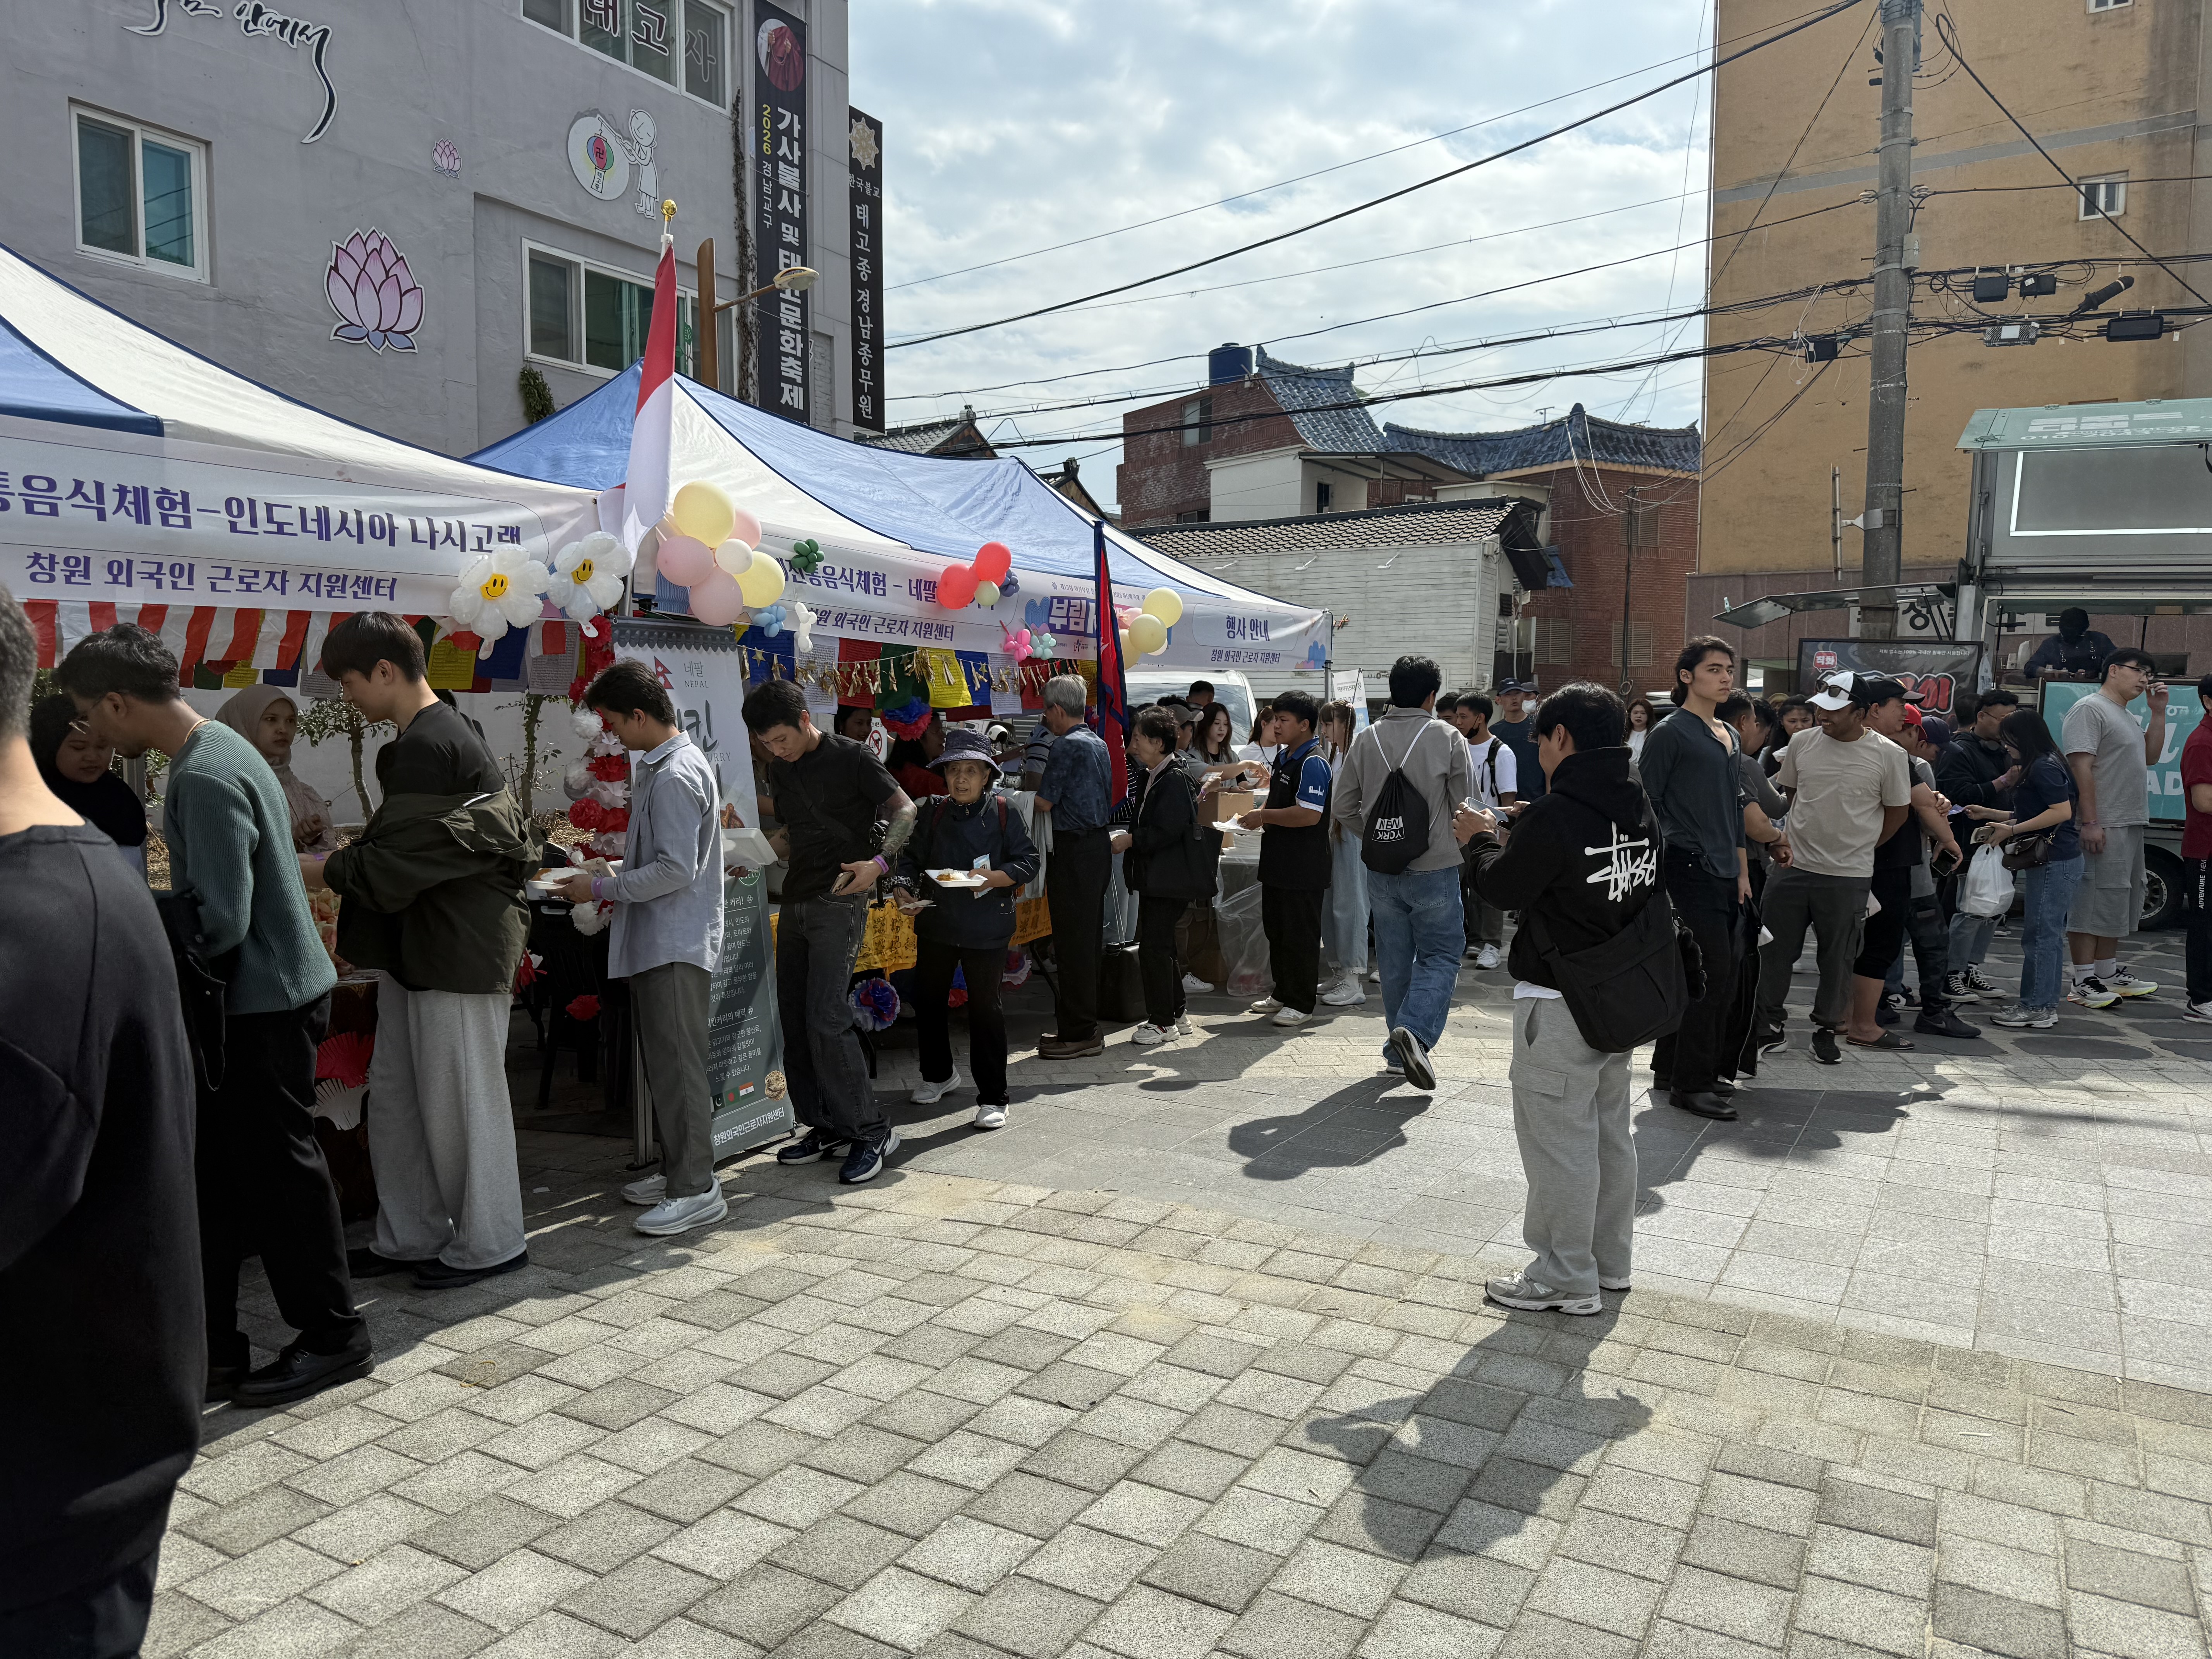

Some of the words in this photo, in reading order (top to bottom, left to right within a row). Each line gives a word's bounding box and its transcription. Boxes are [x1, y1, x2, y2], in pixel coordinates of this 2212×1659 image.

[763, 104, 771, 155] 2026
[776, 106, 802, 218] 가사불사
[848, 173, 880, 198] 한국불교
[763, 160, 773, 228] 경남교구
[781, 222, 800, 247] 및
[855, 203, 871, 282] 태고종
[857, 288, 874, 420] 경남종무원
[26, 551, 91, 586] 창원
[106, 558, 195, 591] 외국인
[206, 564, 290, 596] 근로자
[297, 572, 398, 601] 지원센터
[908, 578, 938, 603] 네팔
[832, 611, 872, 632] 외국인
[874, 616, 909, 637] 근로자
[911, 622, 955, 642] 지원센터
[1226, 615, 1247, 640] 행사
[1250, 618, 1270, 641] 안내
[1211, 649, 1224, 662] 창원
[1224, 650, 1242, 663] 외국인
[1242, 651, 1259, 664] 근로자
[1259, 652, 1281, 664] 지원센터
[1816, 656, 1835, 666] 직화
[684, 661, 704, 677] 네팔
[685, 680, 709, 688] NEPAL
[707, 752, 731, 762] URRY
[1376, 830, 1402, 840] YORK
[729, 896, 744, 907] 커리!
[735, 915, 749, 925] 인도의
[737, 939, 751, 948] 만드는
[744, 961, 754, 969] 여러
[723, 978, 732, 988] 깊고
[733, 974, 747, 985] 풍부한
[711, 993, 721, 1003] 것이
[721, 986, 746, 999] 특징입니다.
[712, 1034, 731, 1046] 닭고기와
[737, 1037, 755, 1051] 감칠맛이
[718, 1056, 738, 1068] 따뜻하고
[738, 1053, 748, 1062] 깊은
[716, 1072, 725, 1082] 느낄
[731, 1063, 752, 1077] 있습니다.
[713, 1107, 785, 1146] 창원외국인근로자지원센터
